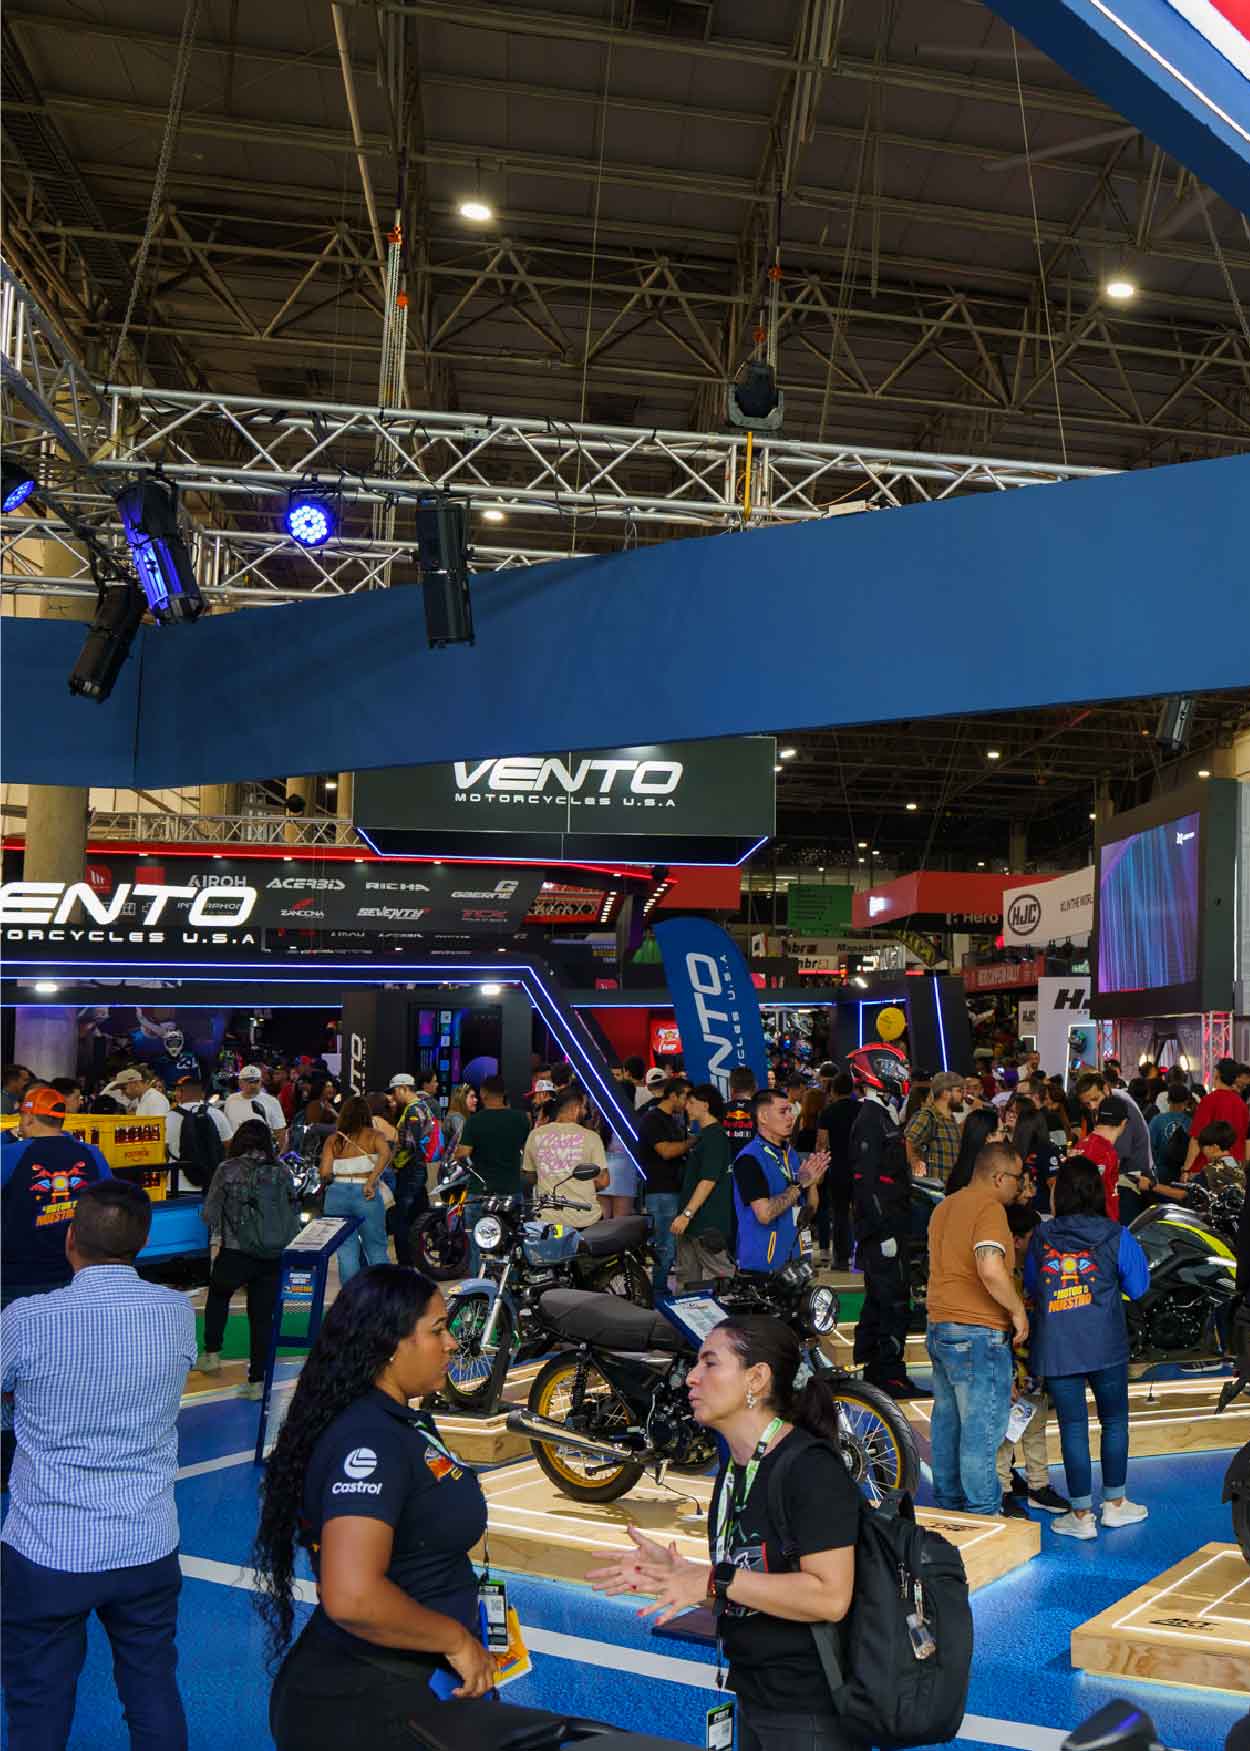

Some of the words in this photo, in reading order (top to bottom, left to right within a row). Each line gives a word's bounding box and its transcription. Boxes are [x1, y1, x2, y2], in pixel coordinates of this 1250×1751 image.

[454, 757, 684, 794] VENTO
[455, 793, 611, 806] MOTORCYCLES
[1012, 904, 1037, 926] HJC
[0, 929, 165, 943] ORCYCLES
[1054, 989, 1088, 1010] H
[332, 1480, 383, 1496] Castrol
